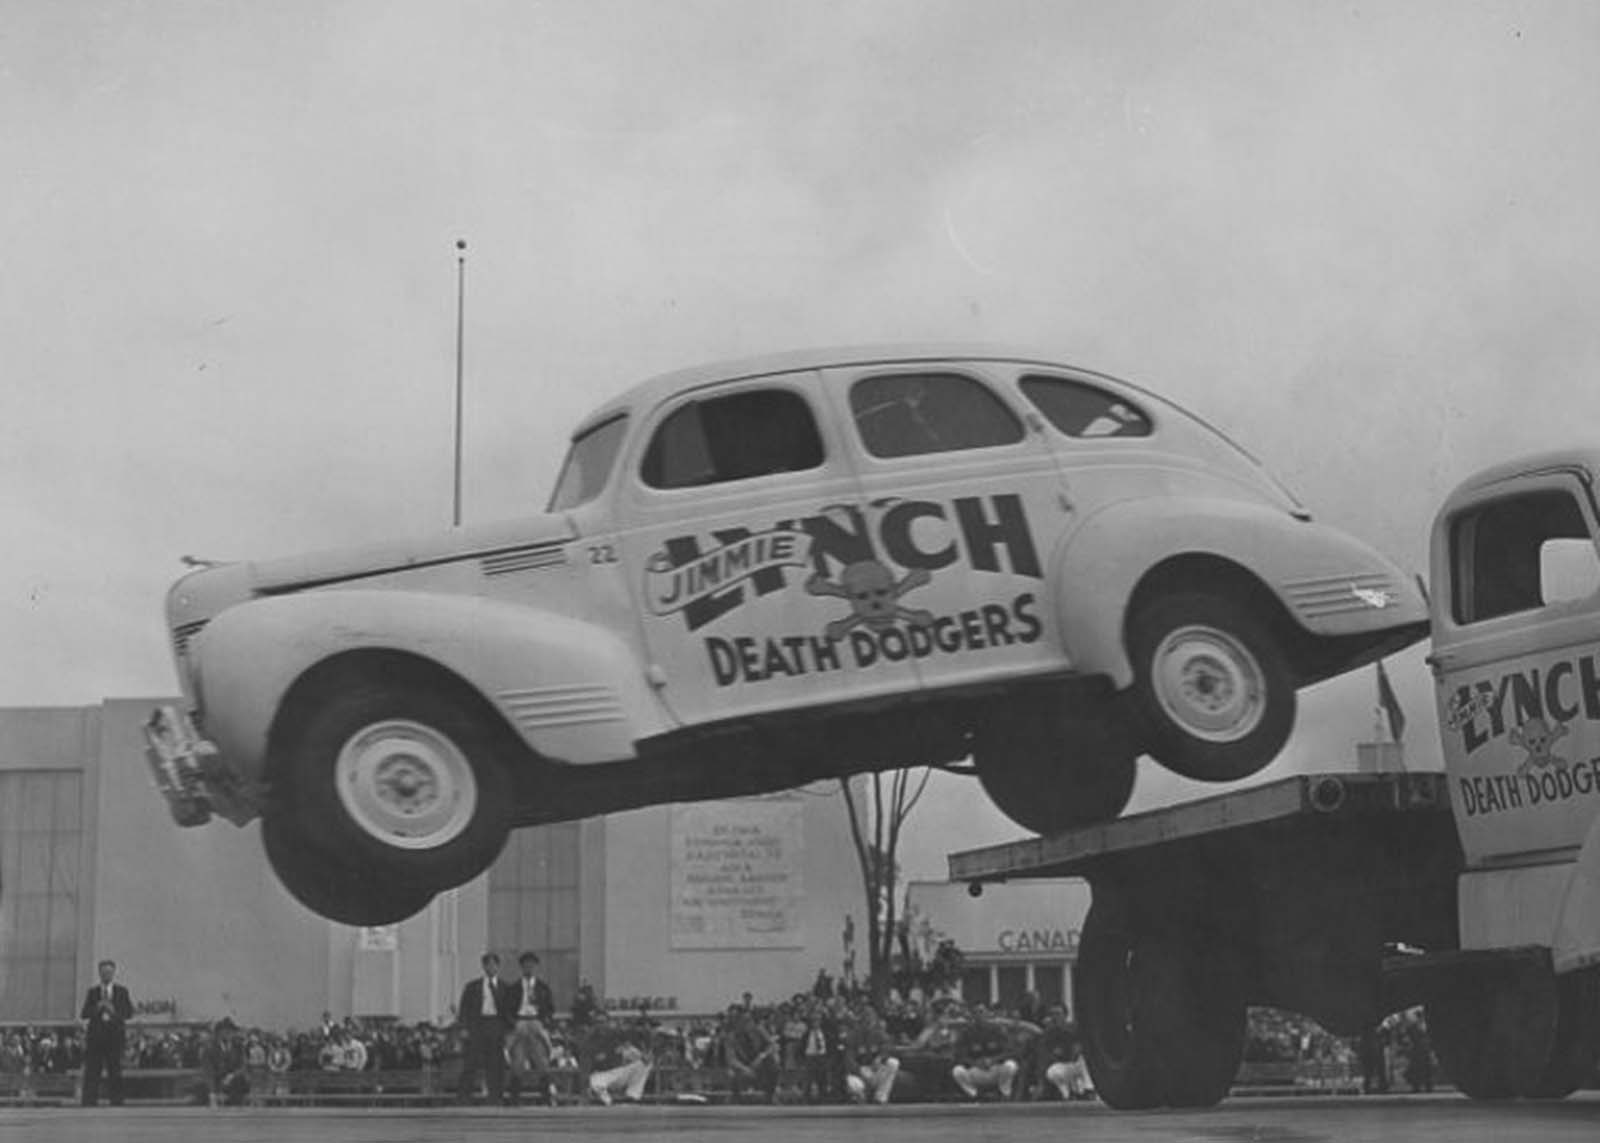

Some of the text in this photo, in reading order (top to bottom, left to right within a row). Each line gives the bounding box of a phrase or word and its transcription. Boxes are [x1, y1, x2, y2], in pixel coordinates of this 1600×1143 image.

[587, 545, 618, 564] 22
[659, 536, 796, 604] JIMMIE
[664, 493, 1044, 632] LYNCH
[705, 593, 1043, 687] DEATH DODGERS
[1460, 775, 1523, 816] DEATH
